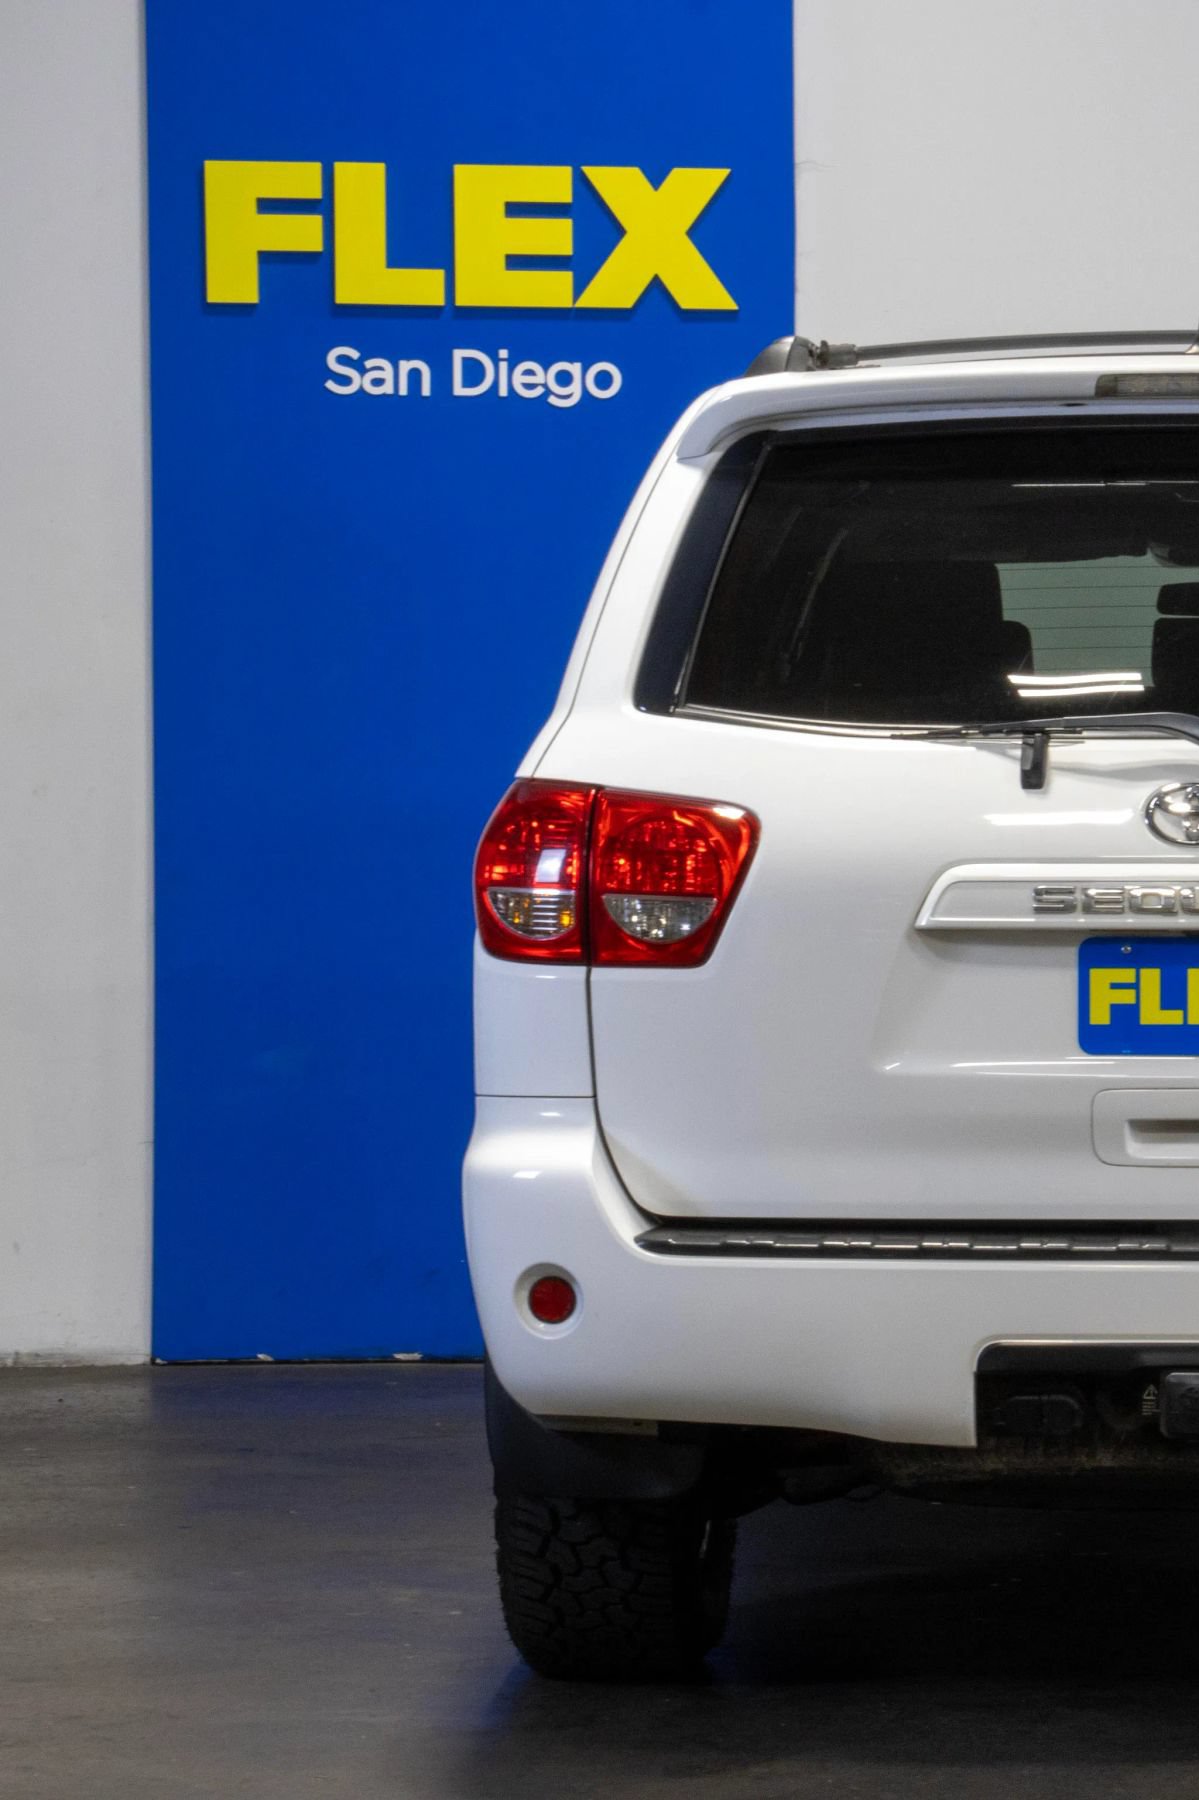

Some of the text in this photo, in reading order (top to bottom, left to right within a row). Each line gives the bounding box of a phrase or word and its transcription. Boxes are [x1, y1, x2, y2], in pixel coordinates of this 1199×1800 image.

[203, 160, 740, 311] FLEX
[324, 346, 623, 408] San Diego
